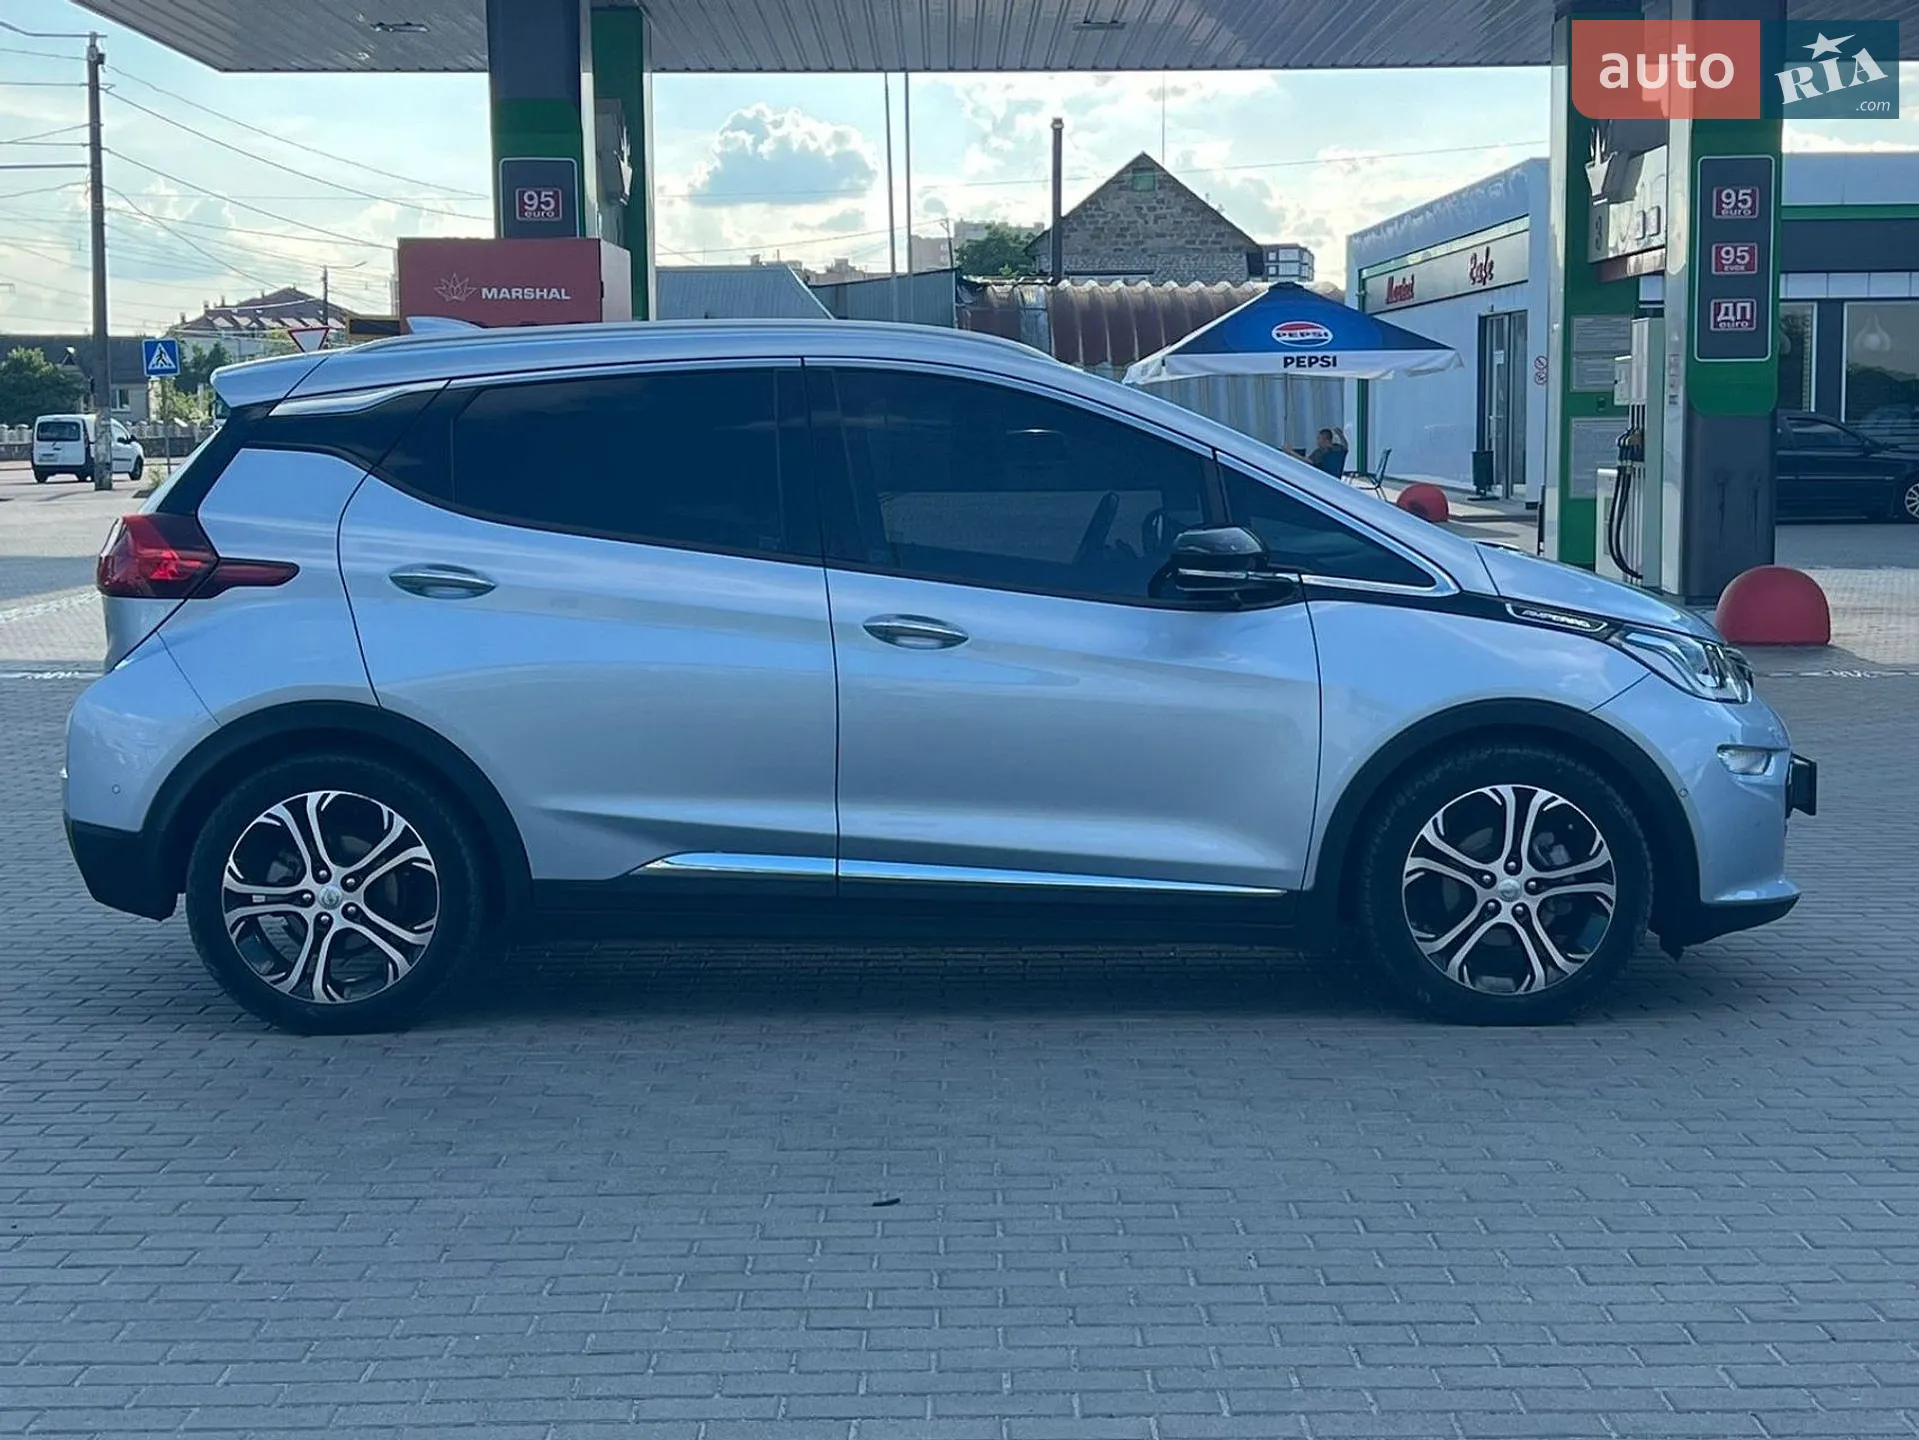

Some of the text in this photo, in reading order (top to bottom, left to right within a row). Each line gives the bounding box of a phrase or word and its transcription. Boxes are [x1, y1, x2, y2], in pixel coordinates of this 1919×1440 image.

[523, 191, 556, 211] 95
[1721, 188, 1753, 209] 95
[1720, 246, 1750, 265] 95
[481, 287, 571, 300] MARSHAL
[1717, 302, 1751, 322] ДП
[1283, 355, 1338, 369] PEPSI
